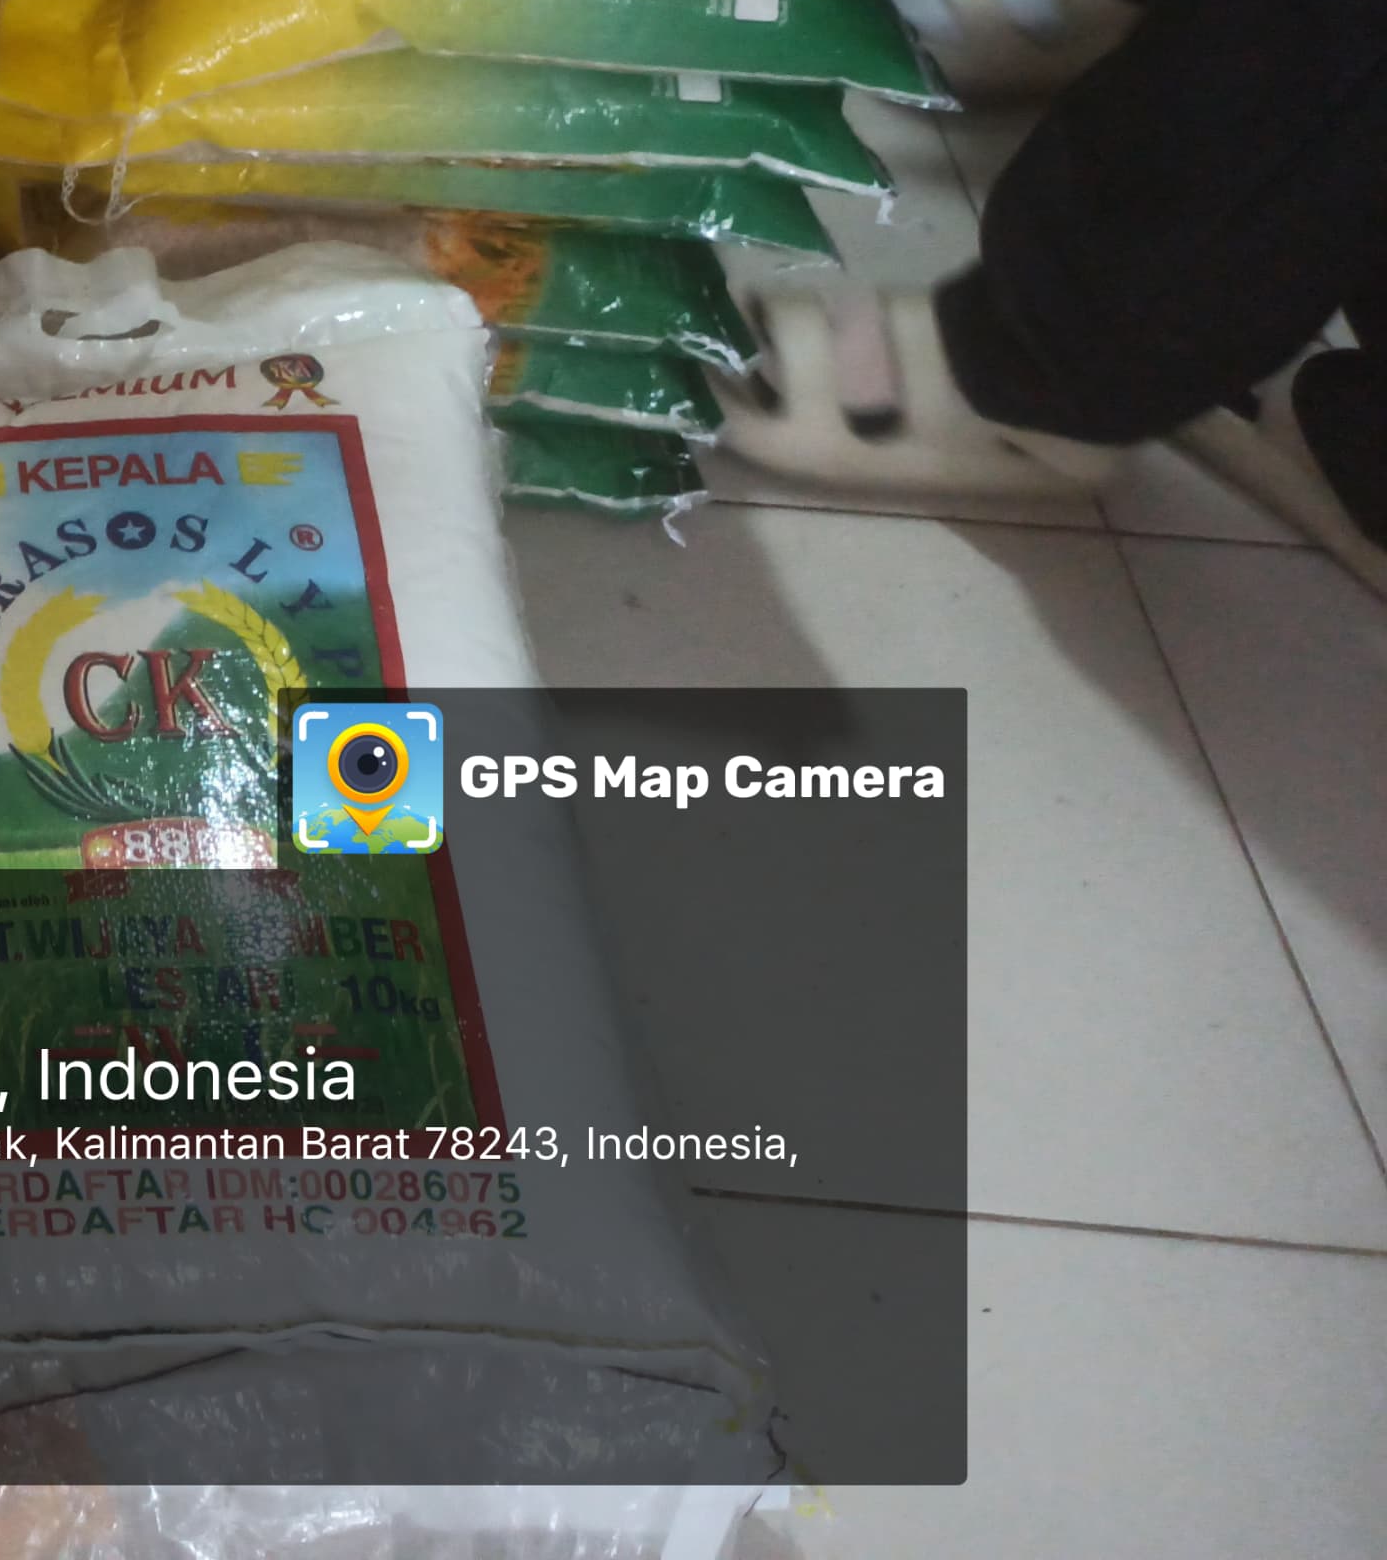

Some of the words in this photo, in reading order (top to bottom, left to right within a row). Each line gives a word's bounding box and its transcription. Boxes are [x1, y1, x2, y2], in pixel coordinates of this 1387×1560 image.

[17, 450, 225, 496] KEPALA
[63, 646, 241, 741] CK
[264, 1203, 335, 1237] HC
